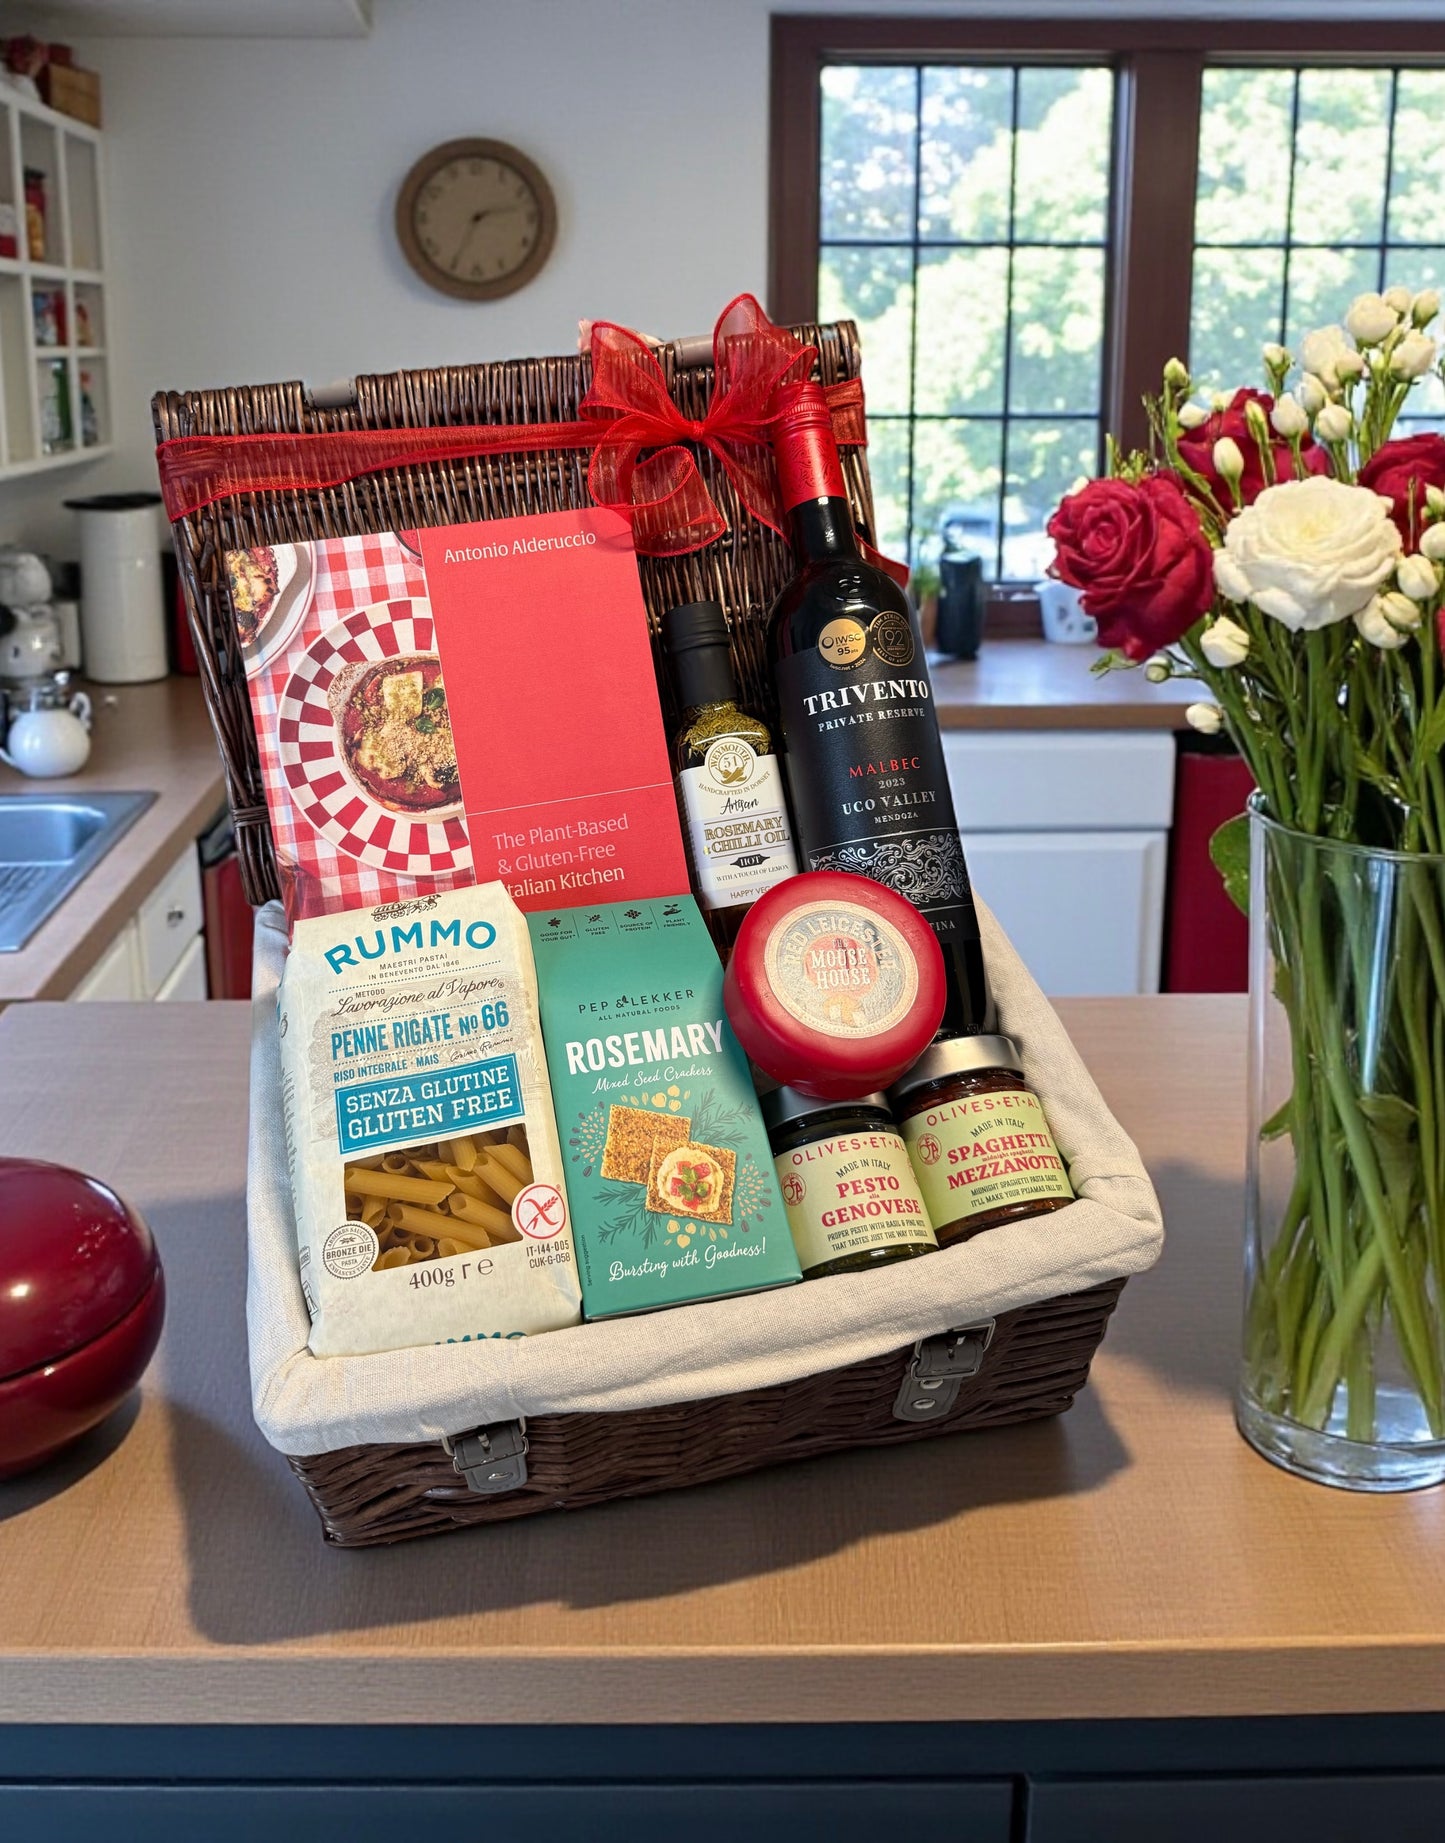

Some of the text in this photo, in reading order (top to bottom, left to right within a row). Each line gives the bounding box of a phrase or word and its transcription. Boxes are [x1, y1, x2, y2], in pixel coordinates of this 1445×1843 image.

[444, 530, 596, 564] Antonio Alderuccio
[835, 633, 861, 645] IWSC
[885, 630, 904, 646] 92
[837, 646, 850, 656] 95
[803, 680, 929, 717] TRIVENTO
[818, 707, 925, 732] PRIVATE RESERVE
[710, 744, 751, 768] WEYMOUTH
[849, 757, 921, 778] MALBEC
[698, 783, 743, 796] HANDCRAFTED
[750, 771, 771, 790] DORSET
[878, 778, 906, 789] 2023
[719, 797, 760, 816] Artisan
[842, 790, 936, 815] UCO VALLEY
[704, 816, 783, 841] ROSEMARY
[874, 812, 918, 824] MENDOZA
[493, 814, 629, 851] The Plant-Based
[711, 836, 763, 853] CHILLI
[764, 829, 790, 844] OIL
[498, 844, 616, 875] & Gluten-Free
[740, 855, 761, 866] HOT
[504, 866, 625, 899] talian Kitchen
[716, 873, 733, 882] WITH
[738, 869, 758, 878] TOUCH
[768, 865, 789, 874] LEMON
[730, 887, 754, 899] HAPPY
[323, 919, 497, 975] RUMMO
[784, 916, 896, 970] RED LEICESTER
[380, 952, 448, 970] MAESTRI PASTAI
[380, 967, 424, 979] BENEVENTO
[443, 959, 460, 967] 1846
[809, 947, 868, 969] MOUSE
[815, 967, 871, 990] HOUSE
[331, 991, 425, 1017] Lavorazione
[427, 981, 445, 998] al
[355, 988, 386, 999] METODO
[578, 989, 695, 1014] PEP & LEKKER
[615, 1009, 651, 1019] NATURAL
[653, 1004, 681, 1013] FOODS
[331, 1024, 389, 1060] PENNE
[393, 1013, 453, 1049] RIGATE
[481, 1000, 510, 1031] 66
[565, 1019, 723, 1075] ROSEMARY
[333, 1053, 440, 1083] RISO INTEGRALE MAIS
[592, 1063, 713, 1094] Mixed Seed Crackers
[346, 1065, 510, 1113] SENZA GLUTINE
[347, 1087, 513, 1139] GLUTEN FREE
[970, 1117, 1025, 1138] MADE IN ITALY
[947, 1133, 1051, 1165] SPAGHETTI
[982, 1152, 1010, 1162] midnight
[836, 1158, 891, 1178] MADE IN ITALY
[947, 1155, 1062, 1190] MEZZANOTTE
[836, 1175, 900, 1199] PESTO
[970, 1183, 999, 1196] MIDNIGHT
[1000, 1177, 1029, 1189] SPAGHETTI
[985, 1193, 1004, 1203] MAKE
[1005, 1189, 1021, 1198] YOUR
[1021, 1185, 1046, 1195] PYJAMAS
[821, 1198, 922, 1228] GENOVESE
[827, 1229, 850, 1241] PROPER
[850, 1225, 868, 1235] PESTO
[869, 1221, 886, 1230] WITH
[885, 1220, 901, 1228] BASIL
[831, 1240, 847, 1251] THAT
[848, 1236, 870, 1247] TASTES
[870, 1233, 884, 1242] JUST
[884, 1231, 895, 1239] THE
[326, 1246, 357, 1260] BRONZE
[358, 1243, 372, 1254] DIE
[341, 1259, 358, 1267] PASTA
[529, 1252, 571, 1269] CUK-G-058
[608, 1236, 767, 1282] Bursting with Goodness!
[409, 1267, 455, 1290] 400g
